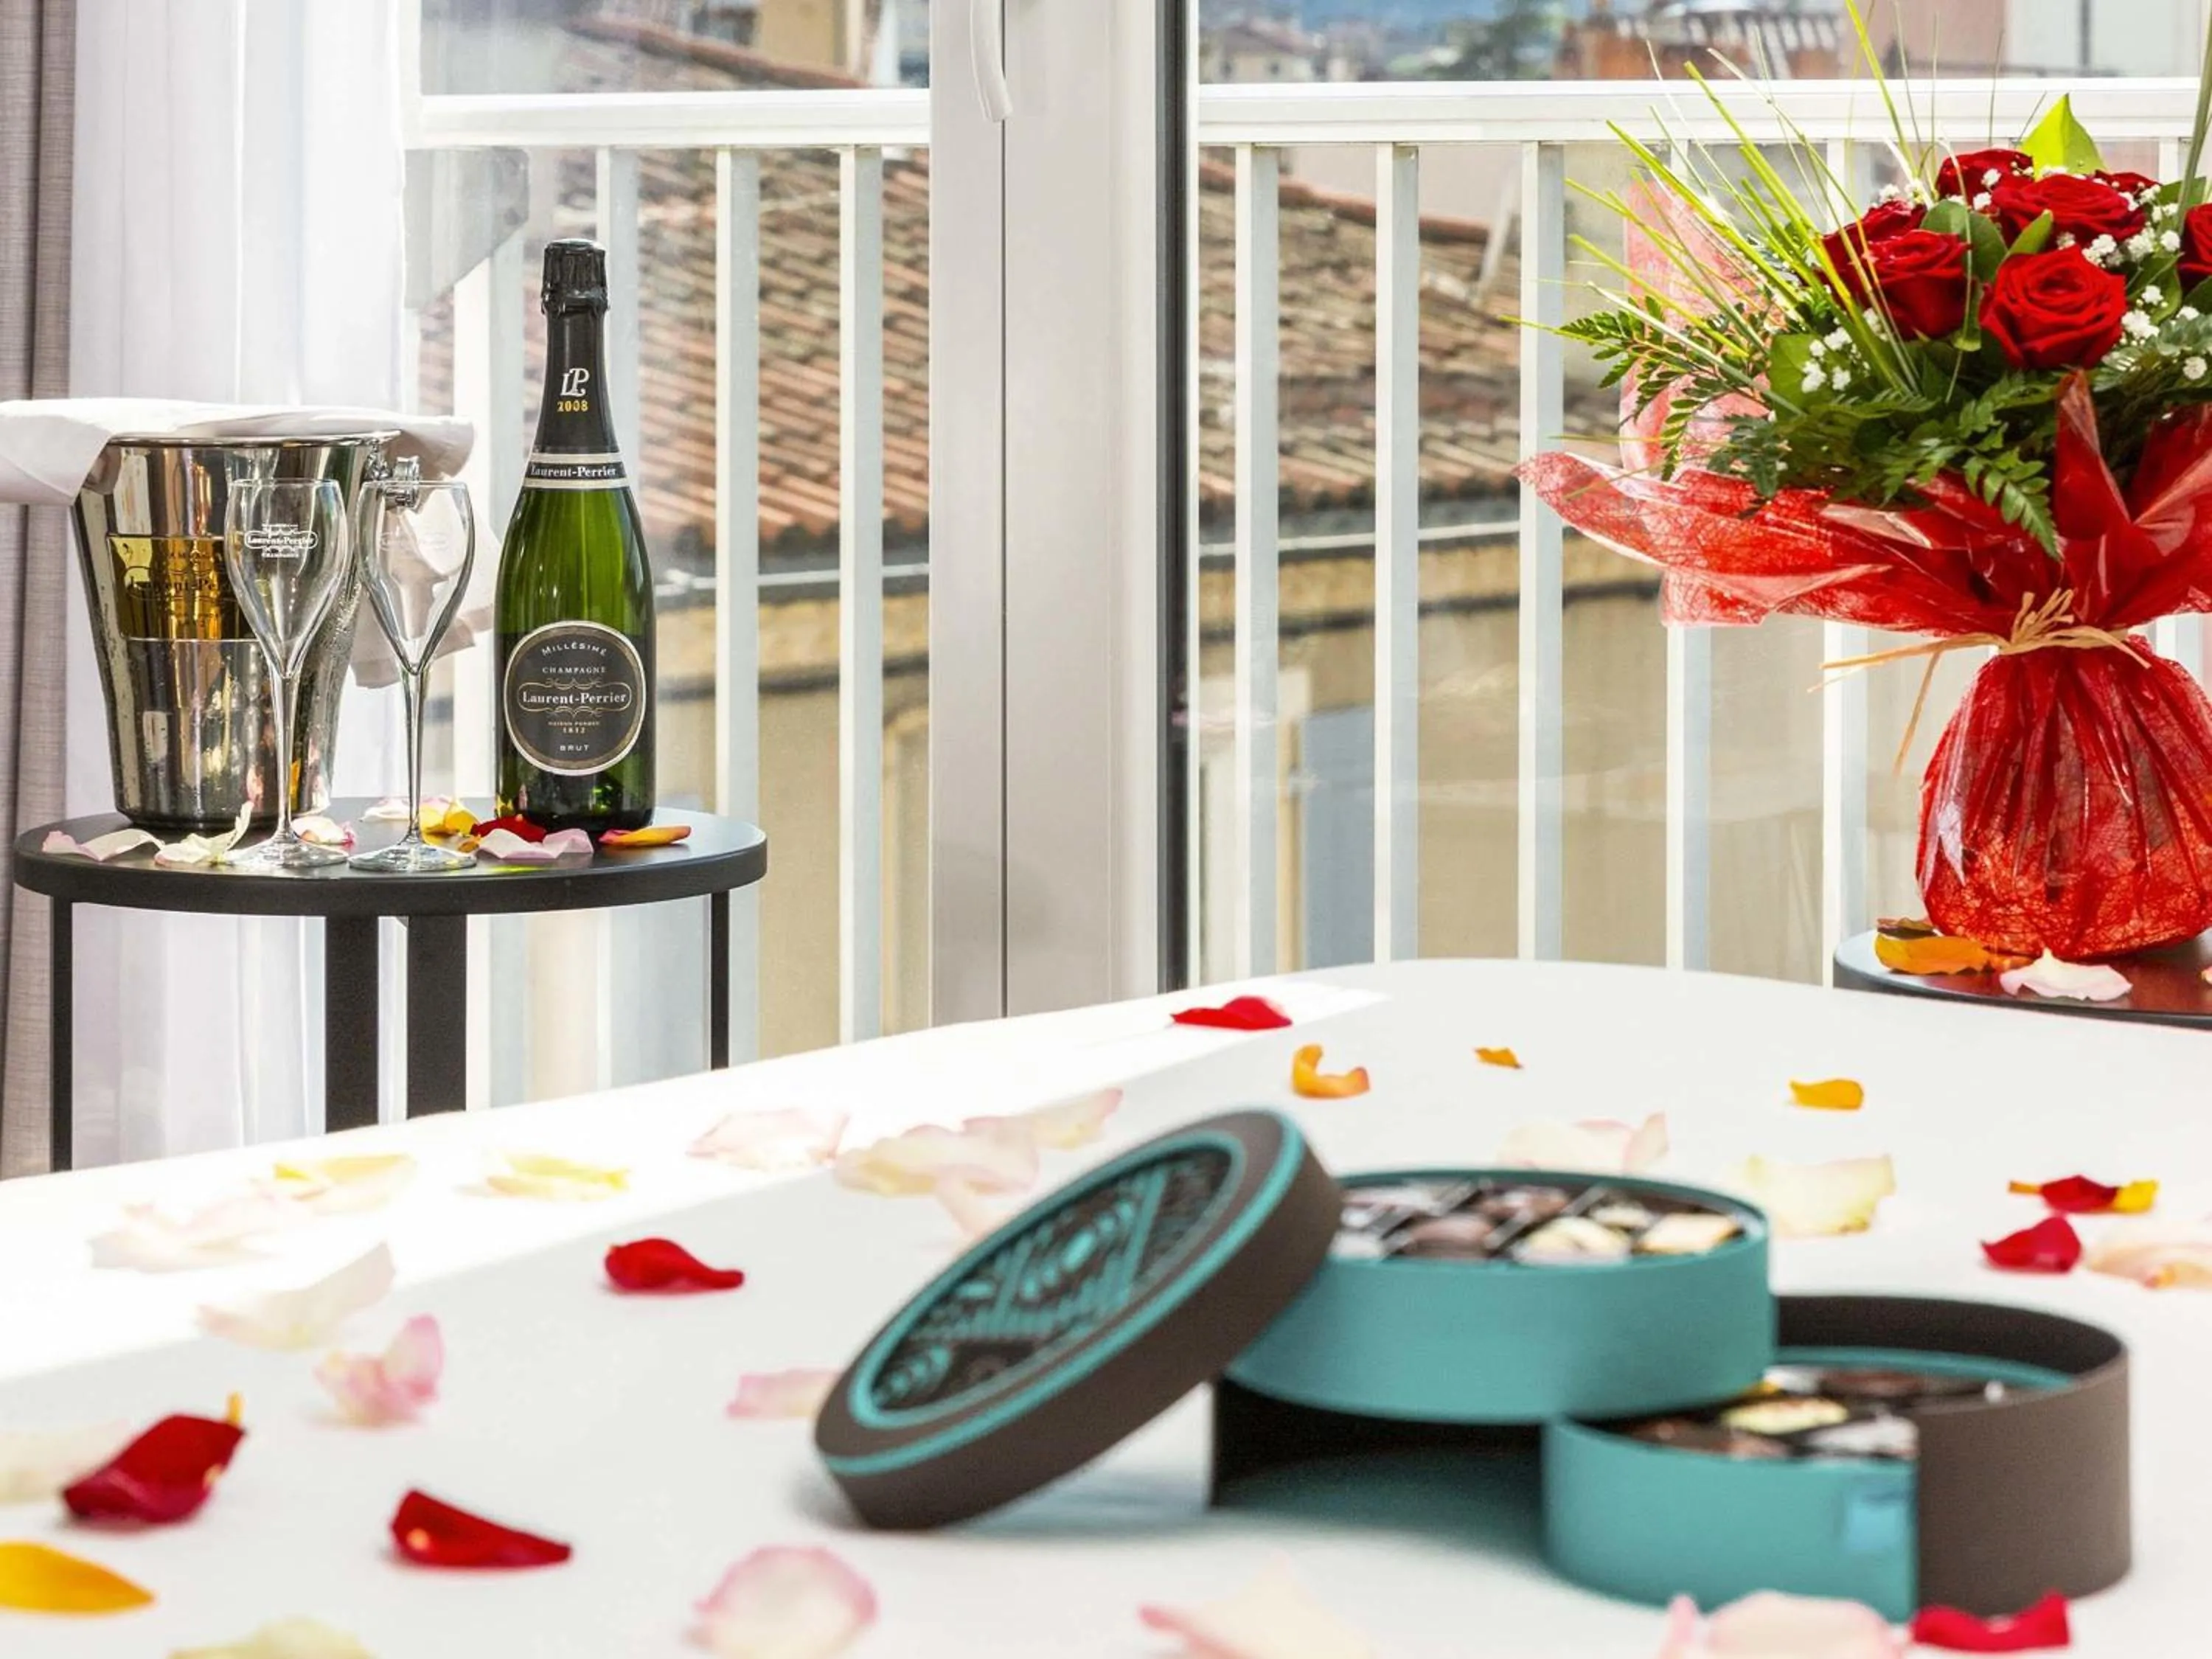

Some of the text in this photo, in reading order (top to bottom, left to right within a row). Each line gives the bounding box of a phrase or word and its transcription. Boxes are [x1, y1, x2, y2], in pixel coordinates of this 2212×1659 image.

[557, 399, 589, 412] 2008
[531, 464, 616, 478] Laurent-Perrier
[523, 691, 627, 704] Laurent-Perrier
